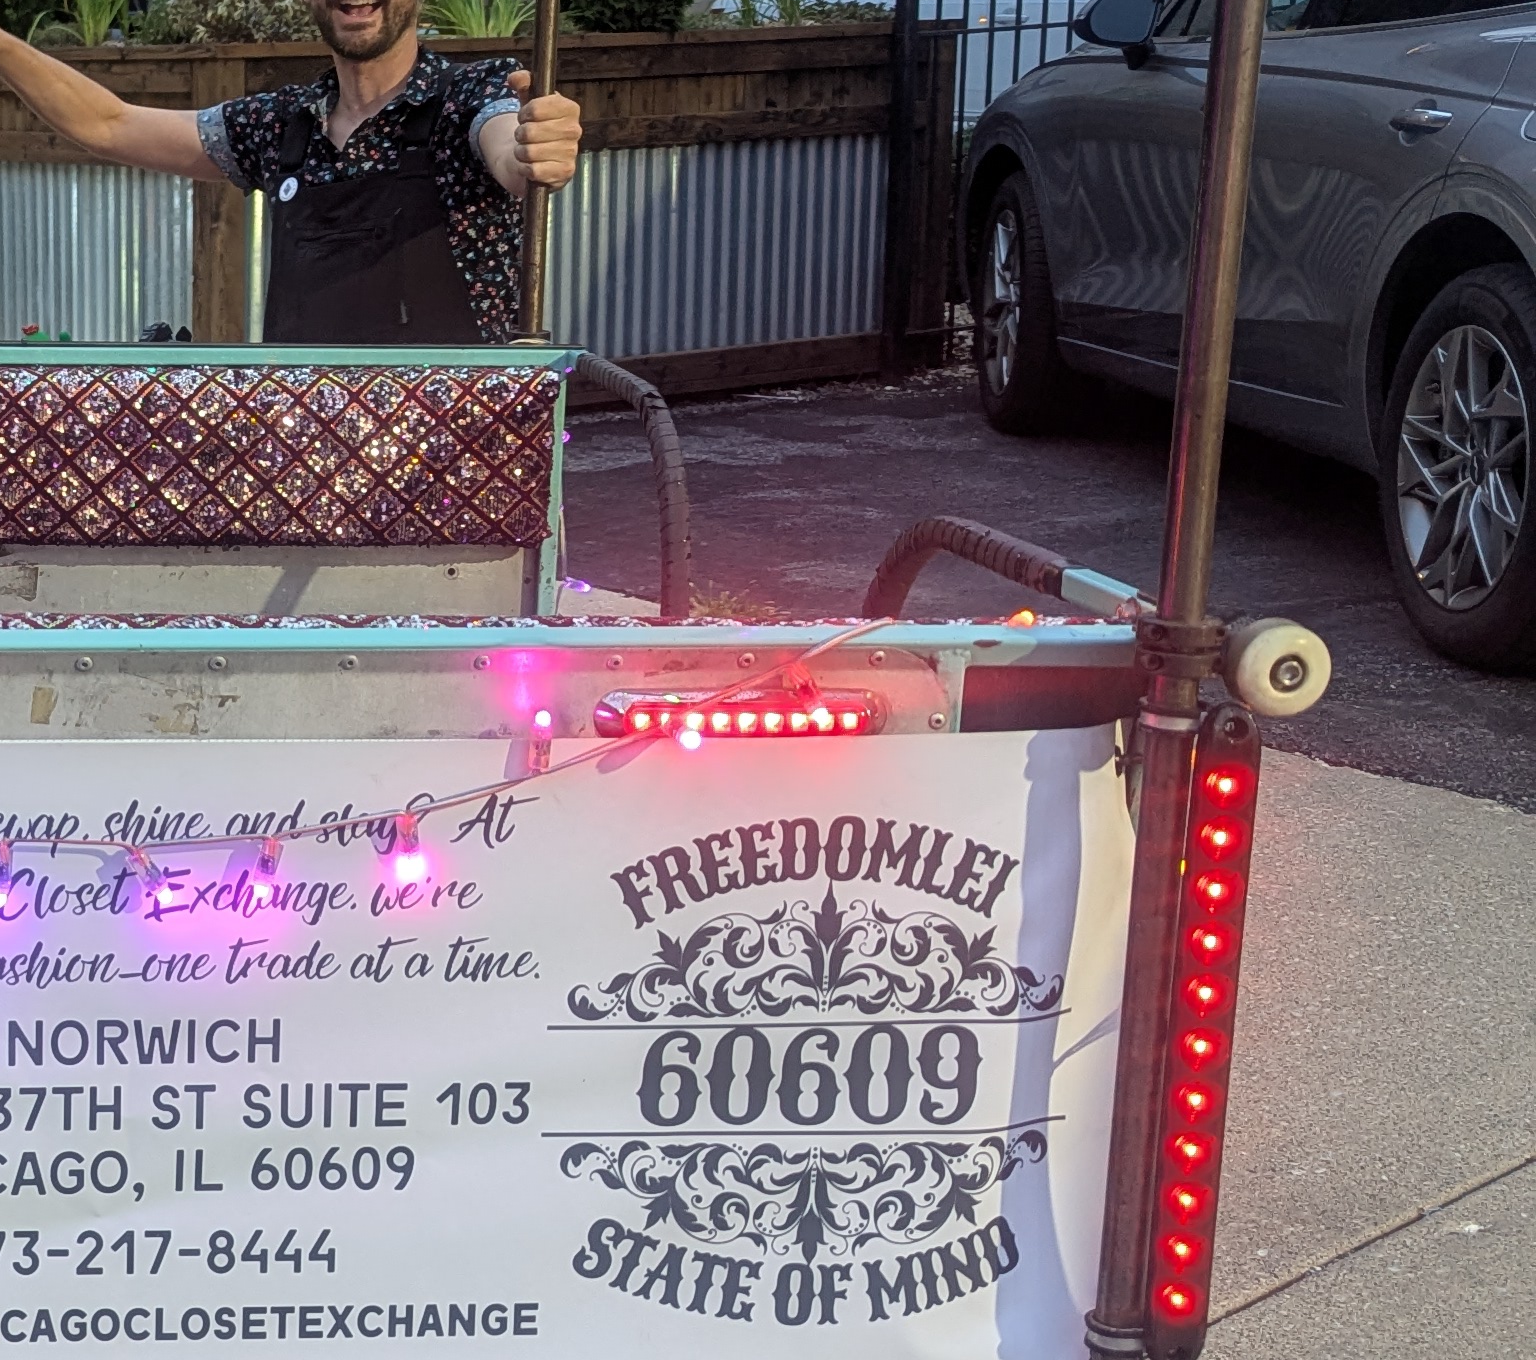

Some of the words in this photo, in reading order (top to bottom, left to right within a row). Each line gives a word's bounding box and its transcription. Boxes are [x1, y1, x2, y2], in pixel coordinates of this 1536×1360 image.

[225, 799, 308, 841] and
[449, 793, 541, 849] At
[610, 815, 1020, 930] FREEDOMLEI
[224, 937, 341, 984] trade
[349, 936, 419, 983] at
[404, 951, 434, 979] a
[443, 936, 541, 983] time.
[7, 1018, 281, 1066] NORWICH
[636, 1024, 984, 1127] 60609
[151, 1083, 217, 1130] ST
[242, 1082, 408, 1128] SUITE
[436, 1081, 531, 1125] 103
[175, 1149, 223, 1191] IL
[251, 1145, 415, 1191] 60609
[571, 1217, 763, 1323] STATE
[770, 1262, 853, 1326] OF
[865, 1215, 1020, 1322] MIND
